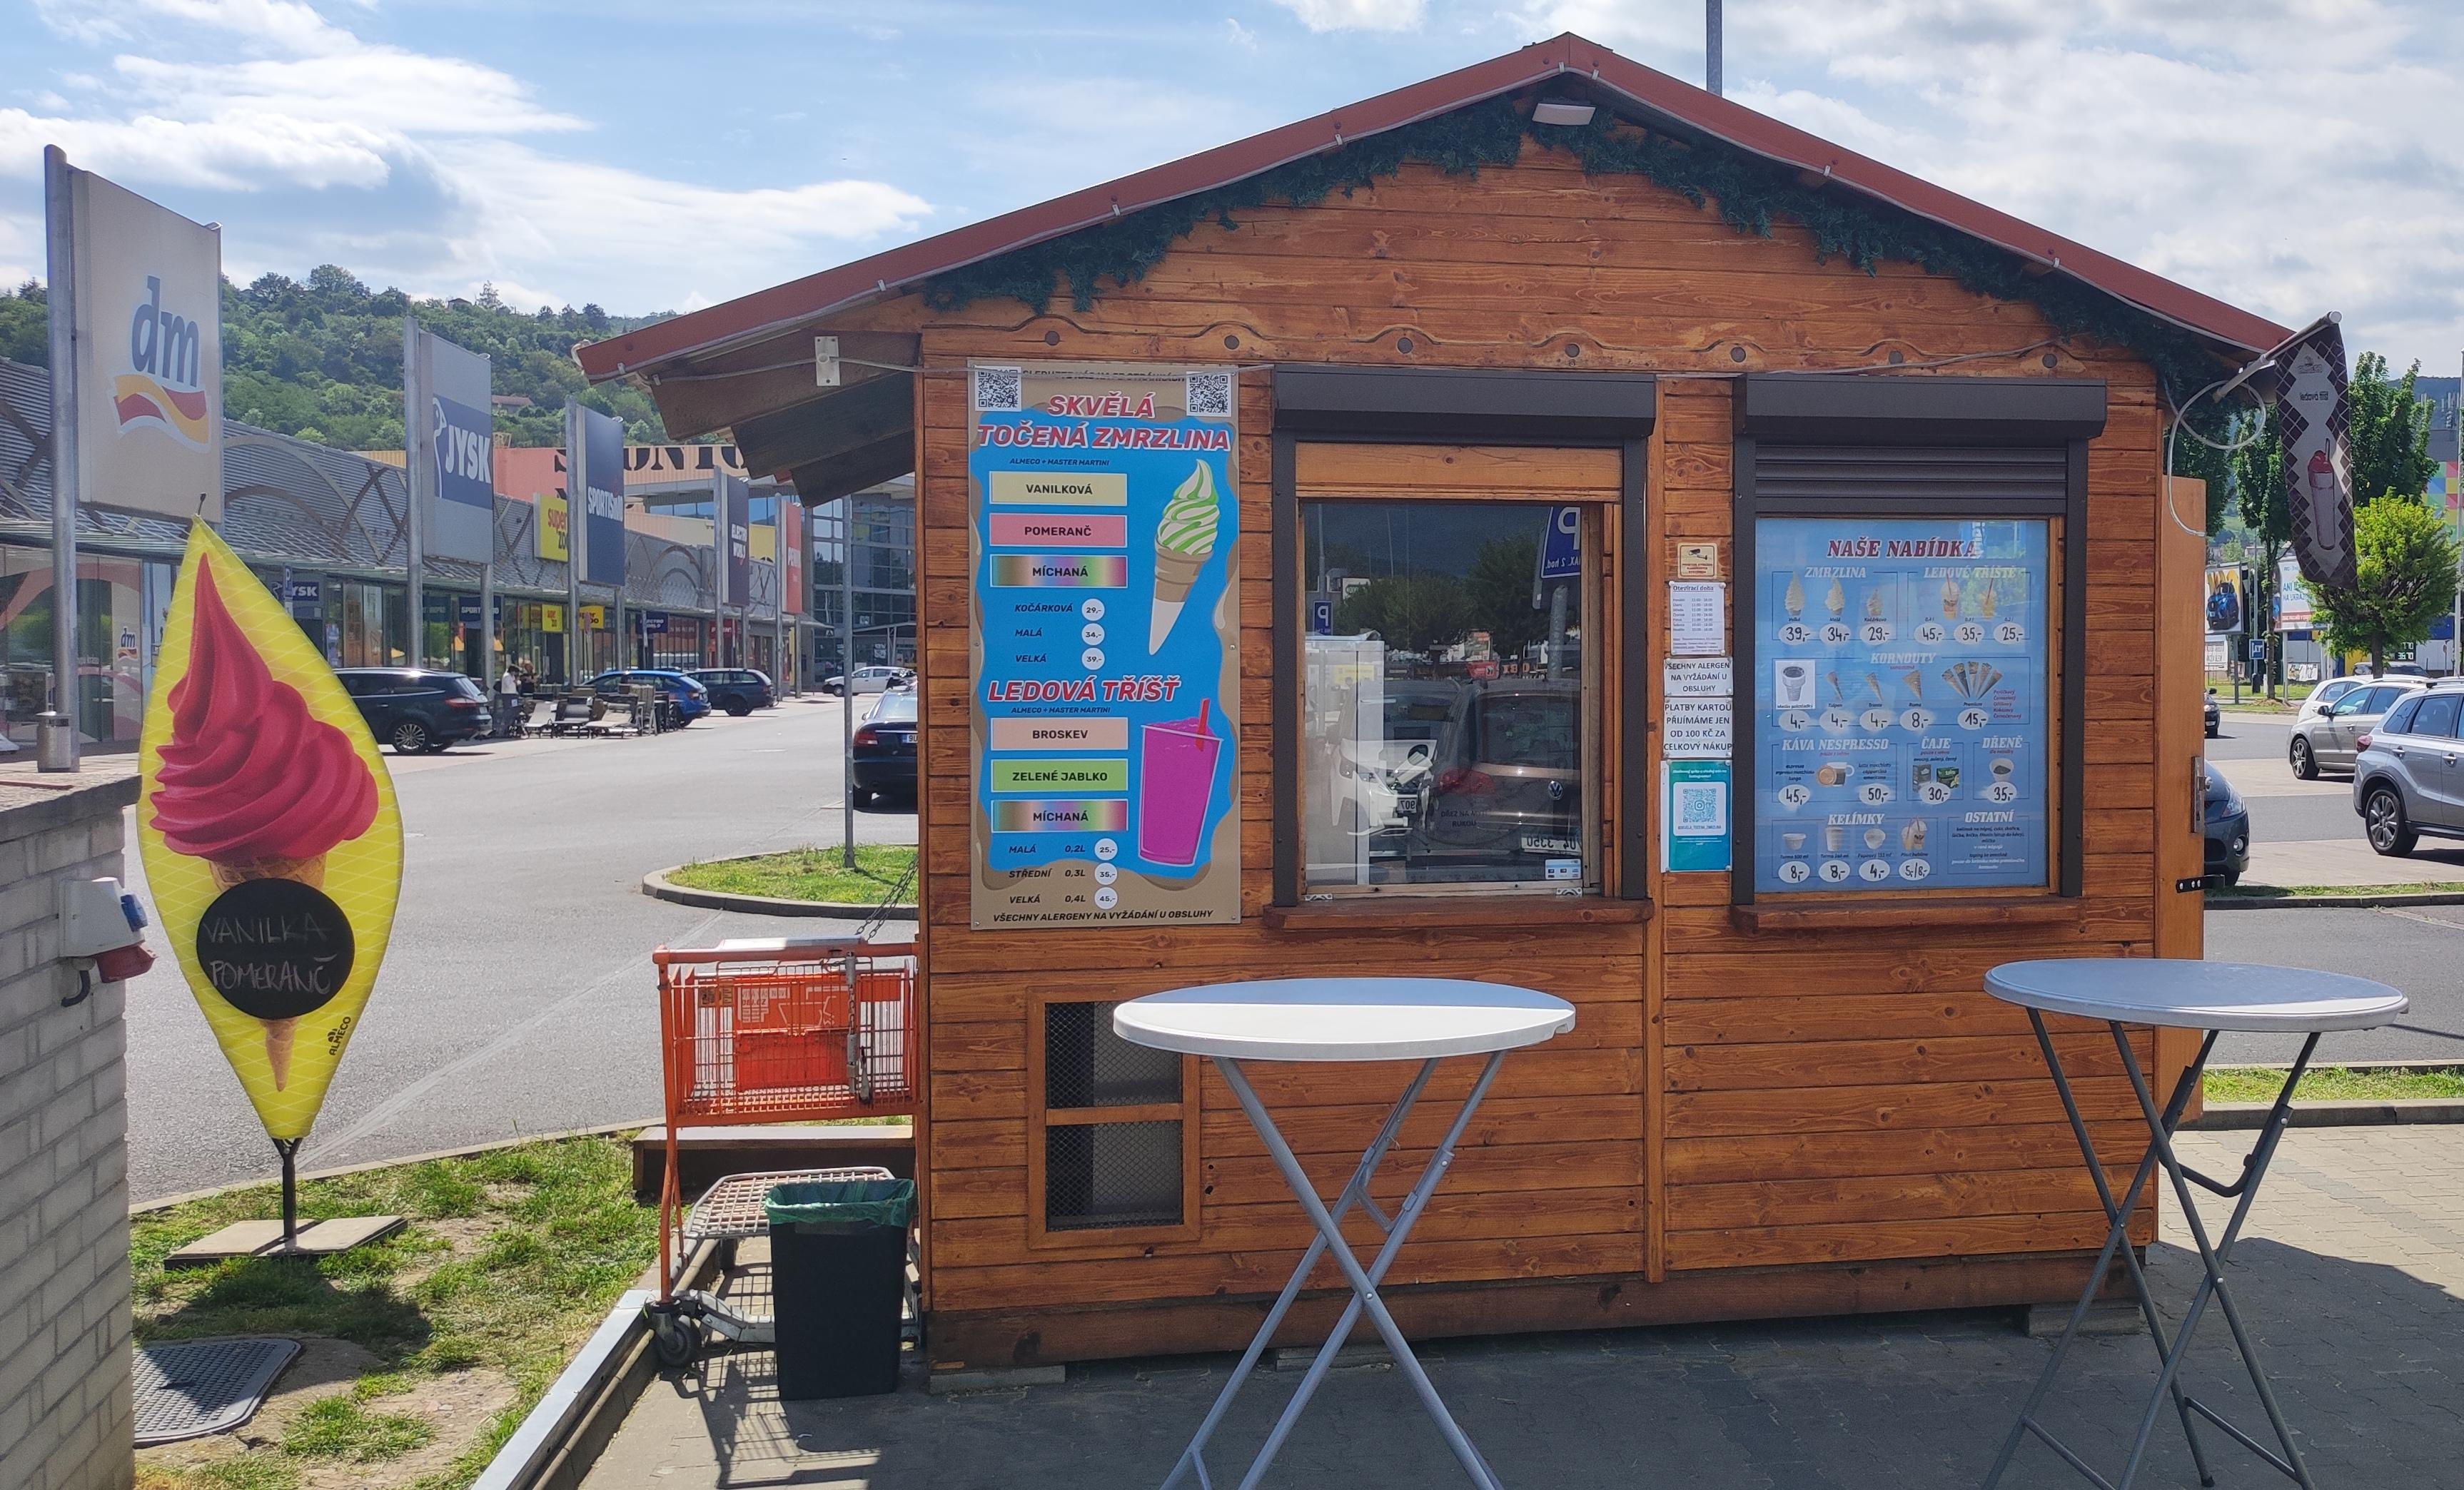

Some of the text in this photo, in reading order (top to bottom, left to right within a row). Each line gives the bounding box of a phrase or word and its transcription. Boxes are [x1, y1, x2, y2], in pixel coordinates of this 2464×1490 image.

[132, 275, 199, 387] dm
[1048, 391, 1156, 418] SKVĚLÁ
[977, 420, 1231, 452] TOČENÁ ZMRZLINA
[445, 424, 492, 484] JYSK
[1026, 483, 1093, 495] VANILKOVÁ
[1024, 525, 1092, 536] POMERANČ
[1827, 536, 1981, 559] NAŠE NABÍDKA
[1032, 566, 1089, 577] MÍCHANÁ
[1804, 567, 1867, 578] ZMRZLINA
[1924, 567, 1974, 578] LEDOVÉ
[292, 586, 318, 597] YSK
[1015, 603, 1073, 612] KOČÁRKOVÁ
[121, 628, 135, 648] dm
[1015, 627, 1042, 637] MALÁ
[1786, 627, 1811, 642] 39,-
[1827, 627, 1849, 642] 34,-
[1868, 627, 1889, 641] 29,-
[1922, 627, 1942, 641] 45,-
[1961, 627, 1982, 642] 35,-
[2002, 627, 2023, 642] 25,-
[1016, 653, 1046, 662] VELKÁ
[1870, 653, 1936, 664] KORNOUTY
[1683, 672, 1720, 681] VYŽÁDÁNÍ
[988, 675, 1181, 701] LEDOVÁ TŘÍŠŤ
[1667, 715, 1713, 724] PŘIJÍMÁME
[1791, 714, 1805, 729] 4,-
[1832, 714, 1848, 728] 4,-
[1912, 712, 1929, 728] 8,-
[1965, 713, 1986, 727] 15,-
[1032, 730, 1088, 739] BROSKEV
[1702, 729, 1713, 737] KČ
[1664, 741, 1732, 751] CELKOVÝ NÁKUP
[1782, 737, 1889, 750] KÁVA NESPRESSO
[1921, 736, 1951, 749] ČAJE
[1981, 735, 2023, 749] DŘENĚ
[1012, 770, 1108, 782] ZELENÉ JABLKO
[1786, 788, 1807, 805] 45,-
[1868, 788, 1889, 802] 50,-
[1929, 787, 1949, 801] 30,-
[1994, 786, 2014, 801] 35,-
[1033, 810, 1089, 821] MÍCHANÁ
[1827, 811, 1884, 825] KELÍMKY
[1964, 809, 2014, 823] OSTATNÍ
[1009, 844, 1036, 853] MALÁ
[1009, 868, 1052, 878] STŘEDNÍ
[1790, 866, 1804, 881] 8,-
[1830, 865, 1845, 880] 8,-
[1870, 864, 1884, 878] 4,-
[1009, 894, 1041, 903] VELKÁ
[993, 913, 1040, 922] VŠECHNY
[1040, 912, 1093, 921] ALERGENY
[1109, 909, 1159, 919] VYŽÁDÁNÍ
[1168, 910, 1213, 918] OBSLUHY
[203, 913, 327, 944] VANILKA
[210, 953, 337, 994] POMERANČ
[329, 1016, 351, 1056] ALMECO
